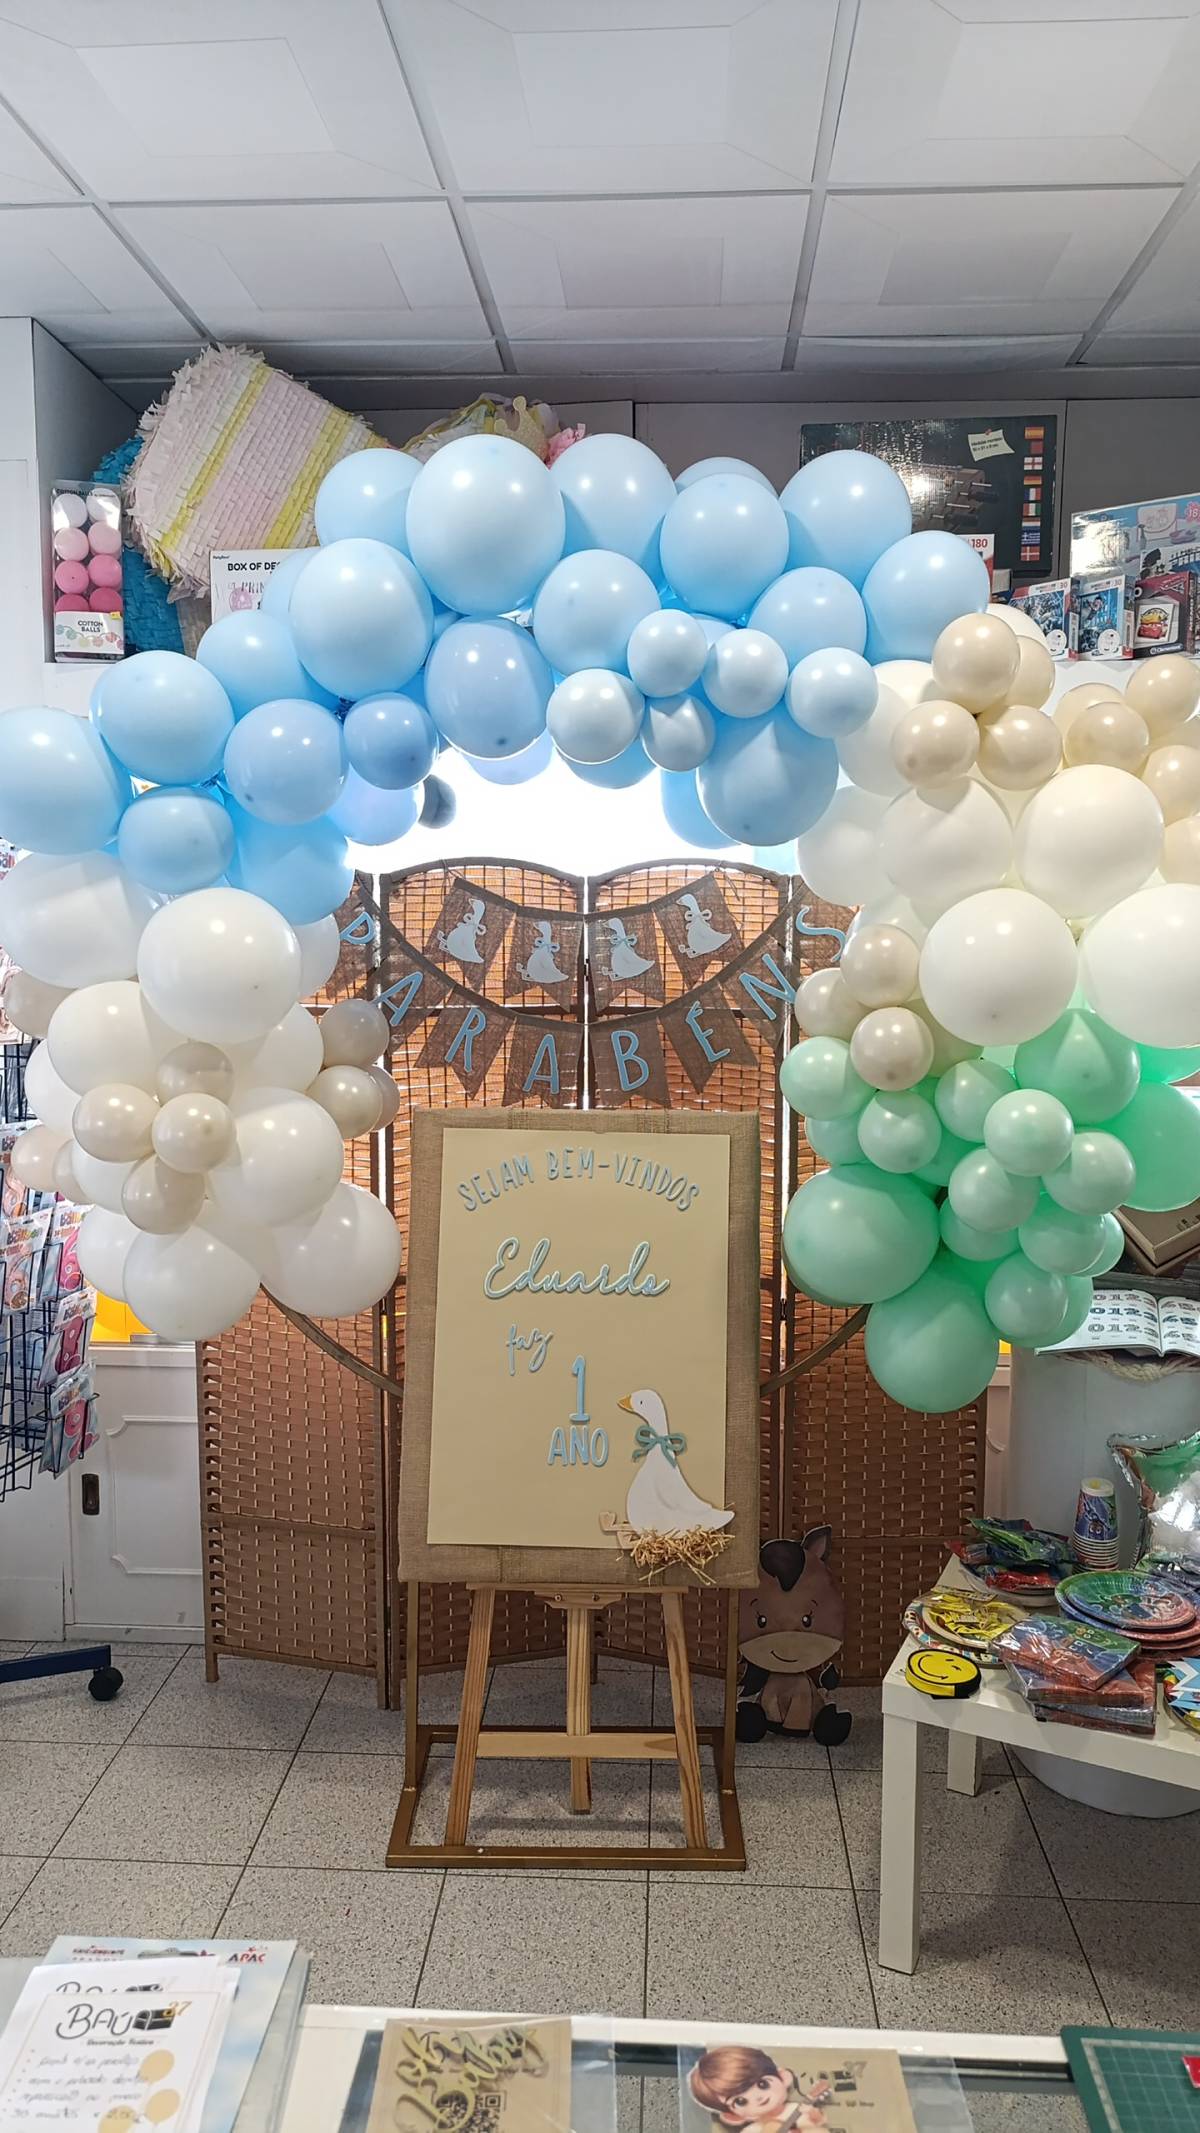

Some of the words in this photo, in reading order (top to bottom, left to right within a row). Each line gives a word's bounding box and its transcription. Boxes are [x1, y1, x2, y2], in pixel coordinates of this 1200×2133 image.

[227, 562, 247, 571] BOX
[249, 562, 262, 571] OF
[264, 561, 281, 571] DE
[970, 538, 988, 549] 180
[457, 1153, 535, 1212] SEJAM
[545, 1146, 701, 1212] BEM-VINDOS
[483, 1236, 671, 1300] Eduardo
[505, 1323, 555, 1377] faz
[569, 1354, 591, 1423] 1
[546, 1424, 610, 1467] ANO
[55, 2002, 134, 2040] BAÚ
